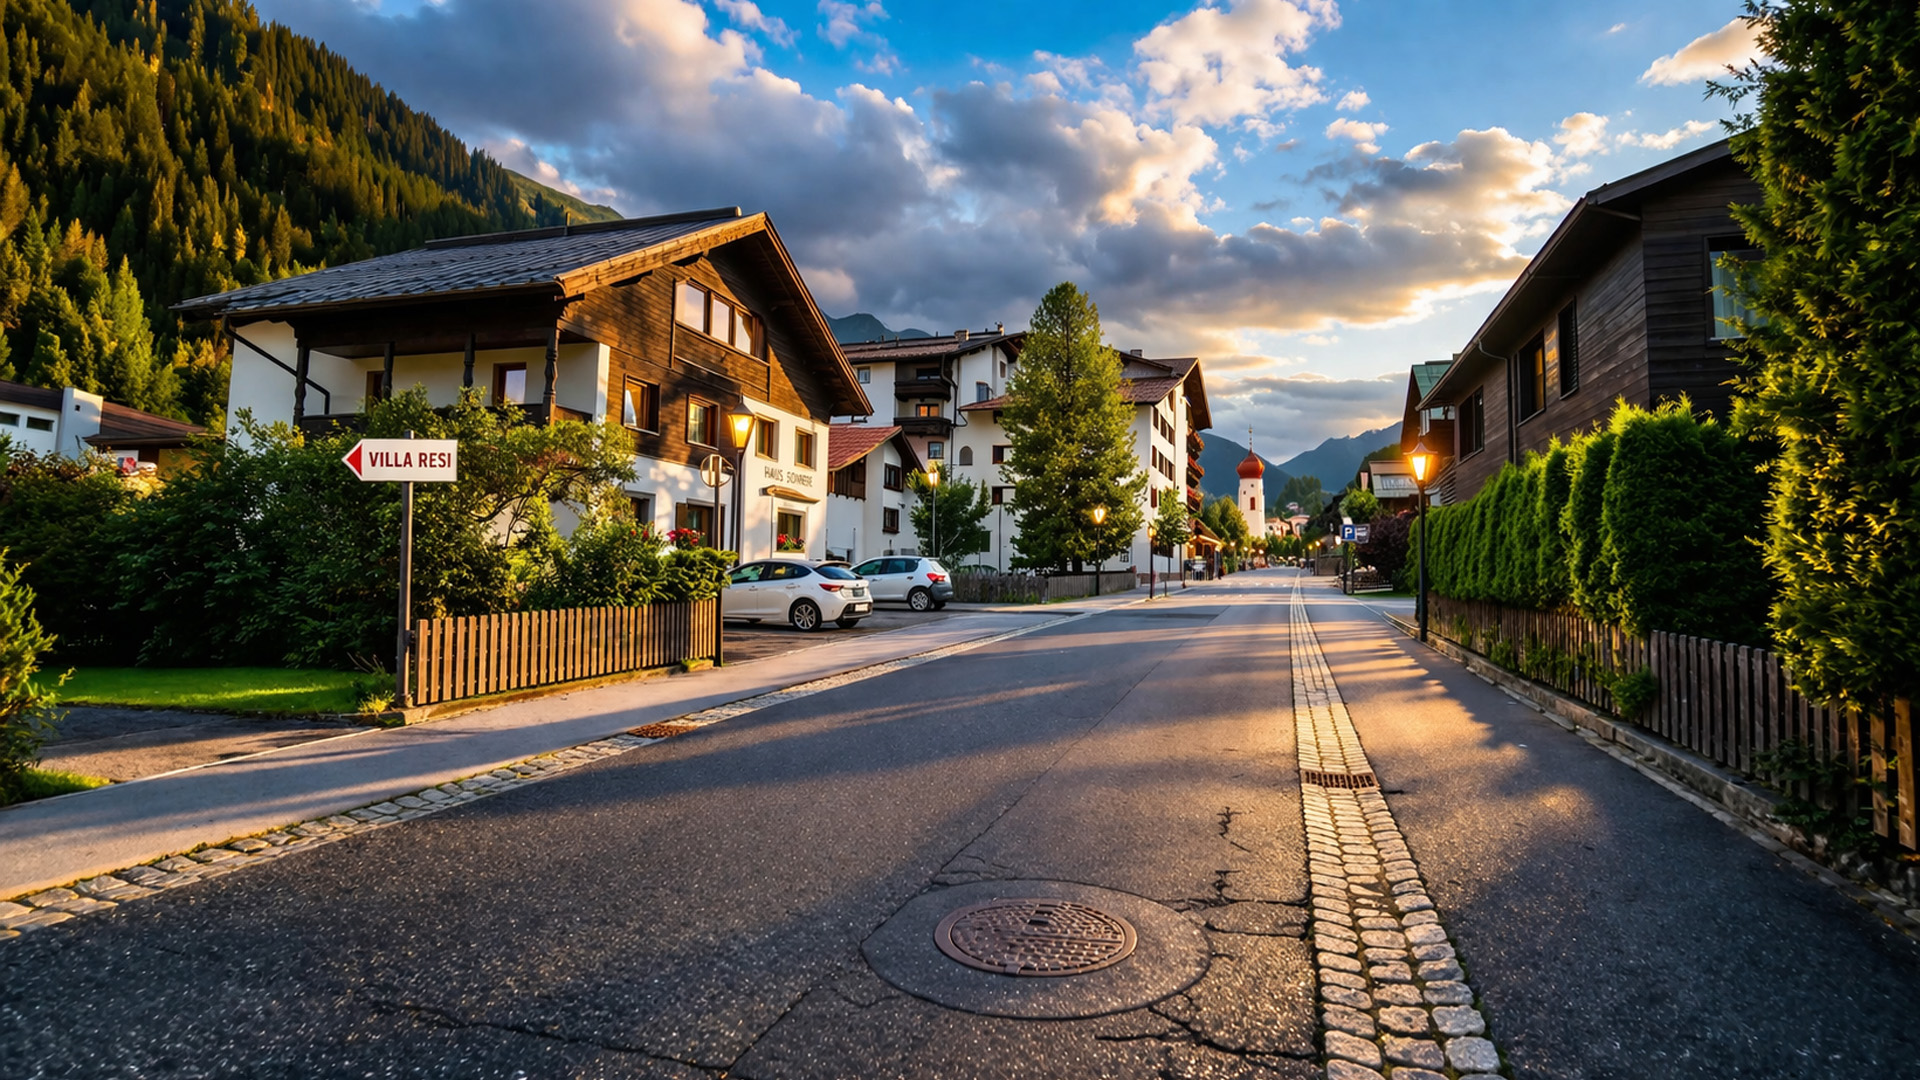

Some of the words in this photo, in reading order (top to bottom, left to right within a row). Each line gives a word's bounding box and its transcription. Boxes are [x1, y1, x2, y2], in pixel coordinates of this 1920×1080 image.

[369, 451, 413, 468] VILLA
[418, 452, 451, 468] RESI
[1345, 527, 1353, 539] P
